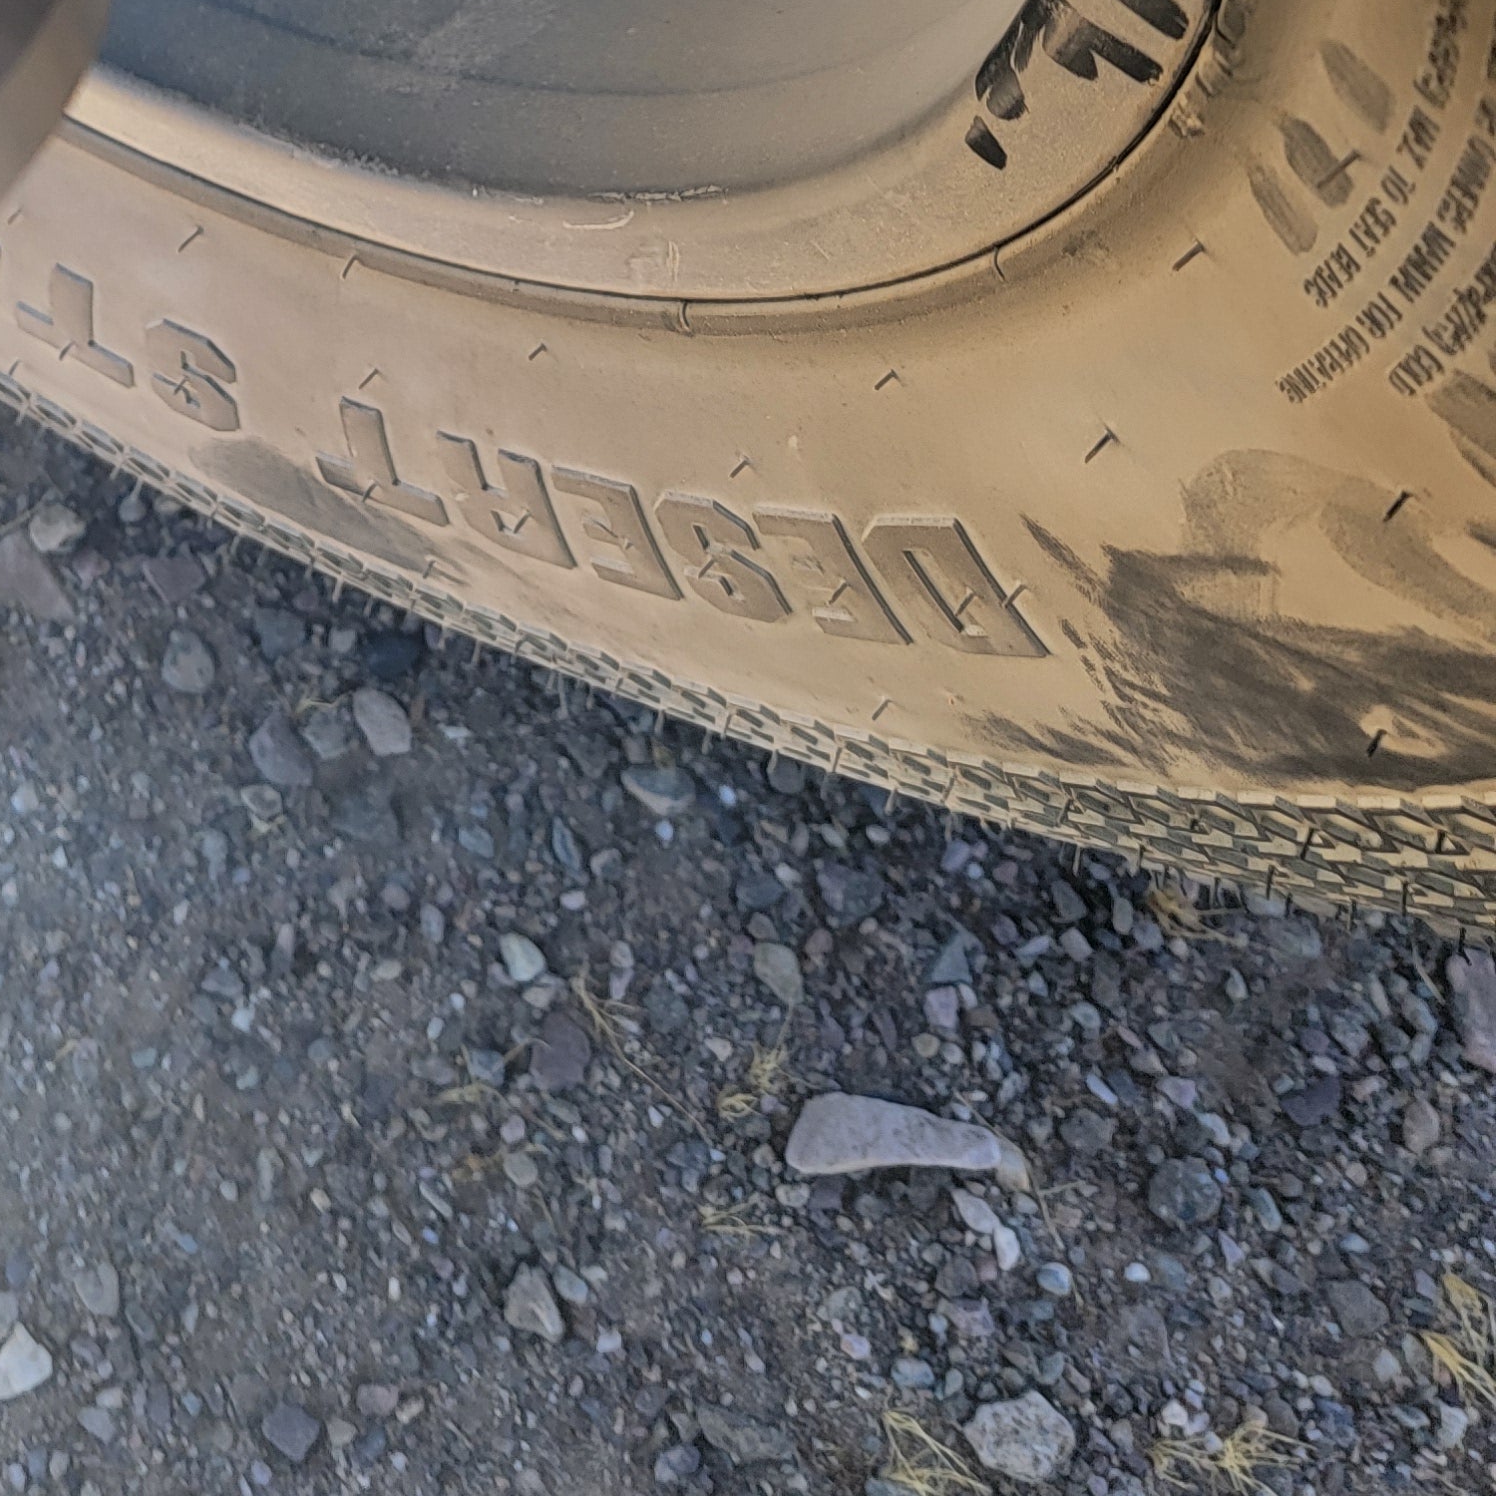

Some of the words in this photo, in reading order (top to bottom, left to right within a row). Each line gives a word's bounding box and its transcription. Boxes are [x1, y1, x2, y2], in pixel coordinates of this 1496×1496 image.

[1379, 164, 1417, 206] TO
[1348, 196, 1398, 259] SEAT
[1303, 242, 1362, 308] BEADS
[1355, 291, 1404, 339] FOR
[1387, 343, 1446, 397] COLD
[314, 395, 1051, 659] DESERT
